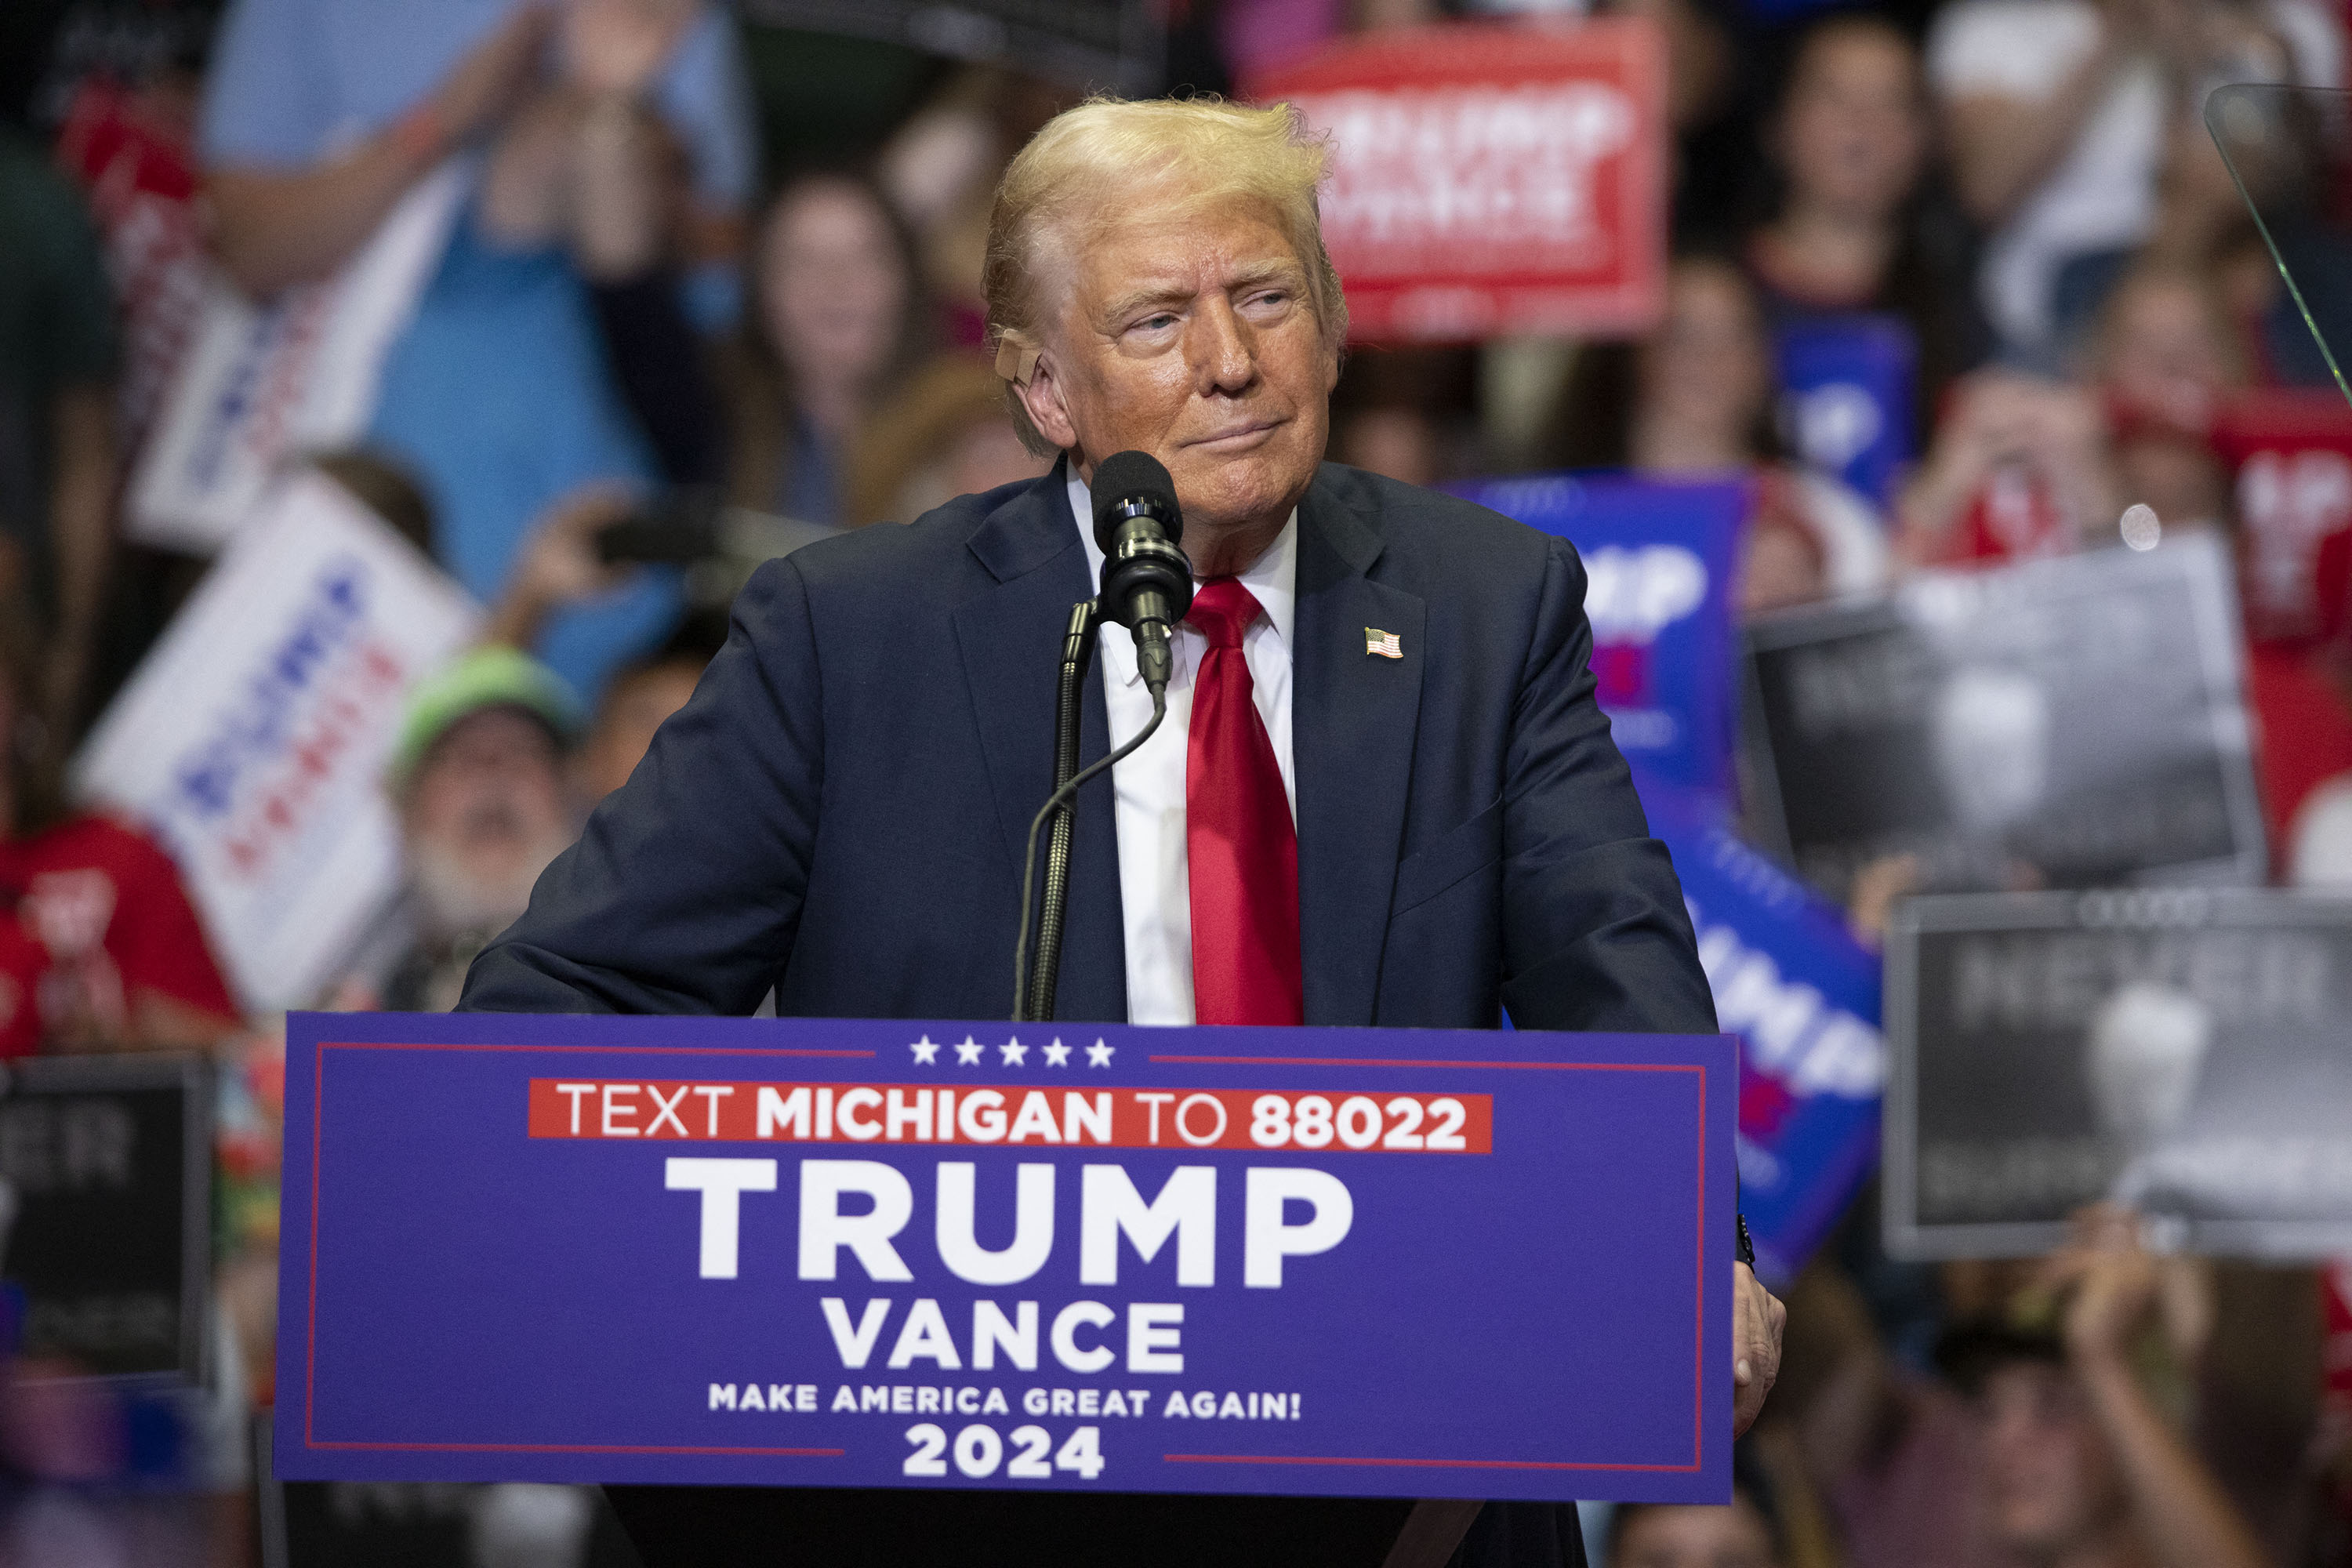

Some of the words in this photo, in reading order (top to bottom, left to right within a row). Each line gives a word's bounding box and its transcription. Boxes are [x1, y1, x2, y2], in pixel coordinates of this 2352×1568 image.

[556, 1083, 735, 1138] TEXT
[756, 1087, 1113, 1144] MICHIGAN
[1134, 1092, 1229, 1146] TO
[1249, 1094, 1466, 1151] 88022
[664, 1157, 1354, 1289] TRUMP
[820, 1297, 1185, 1374] VANCE
[709, 1383, 818, 1412] MAKE
[831, 1385, 1010, 1415] AMERICA
[1023, 1388, 1151, 1417] GREAT
[1163, 1390, 1301, 1420] AGAIN!
[903, 1423, 1105, 1479] 2024
